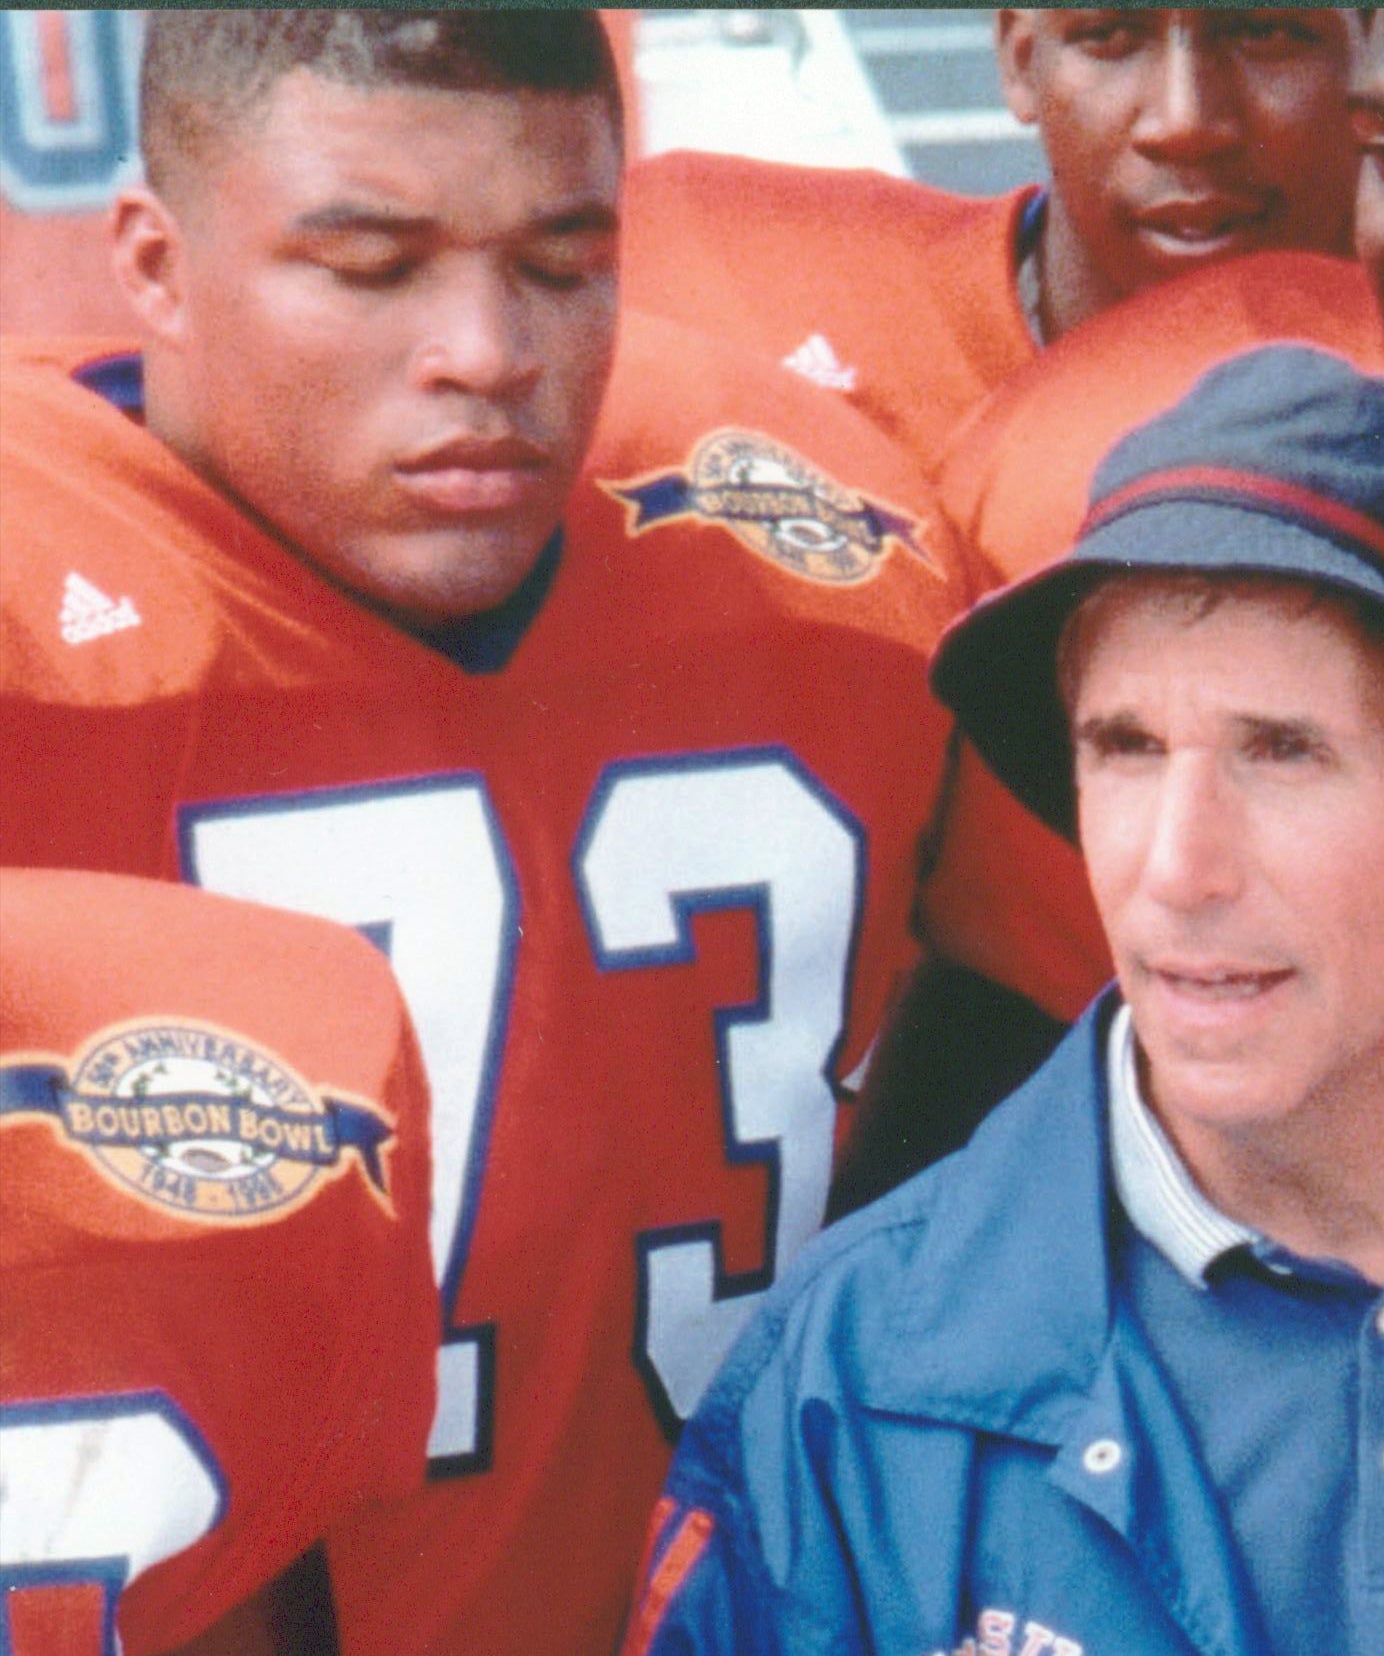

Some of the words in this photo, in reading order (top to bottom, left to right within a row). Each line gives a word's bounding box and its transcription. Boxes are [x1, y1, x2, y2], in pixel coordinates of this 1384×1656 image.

[67, 1101, 232, 1140] BOURBON
[238, 1107, 334, 1155] BOWL
[177, 743, 869, 1482] 73
